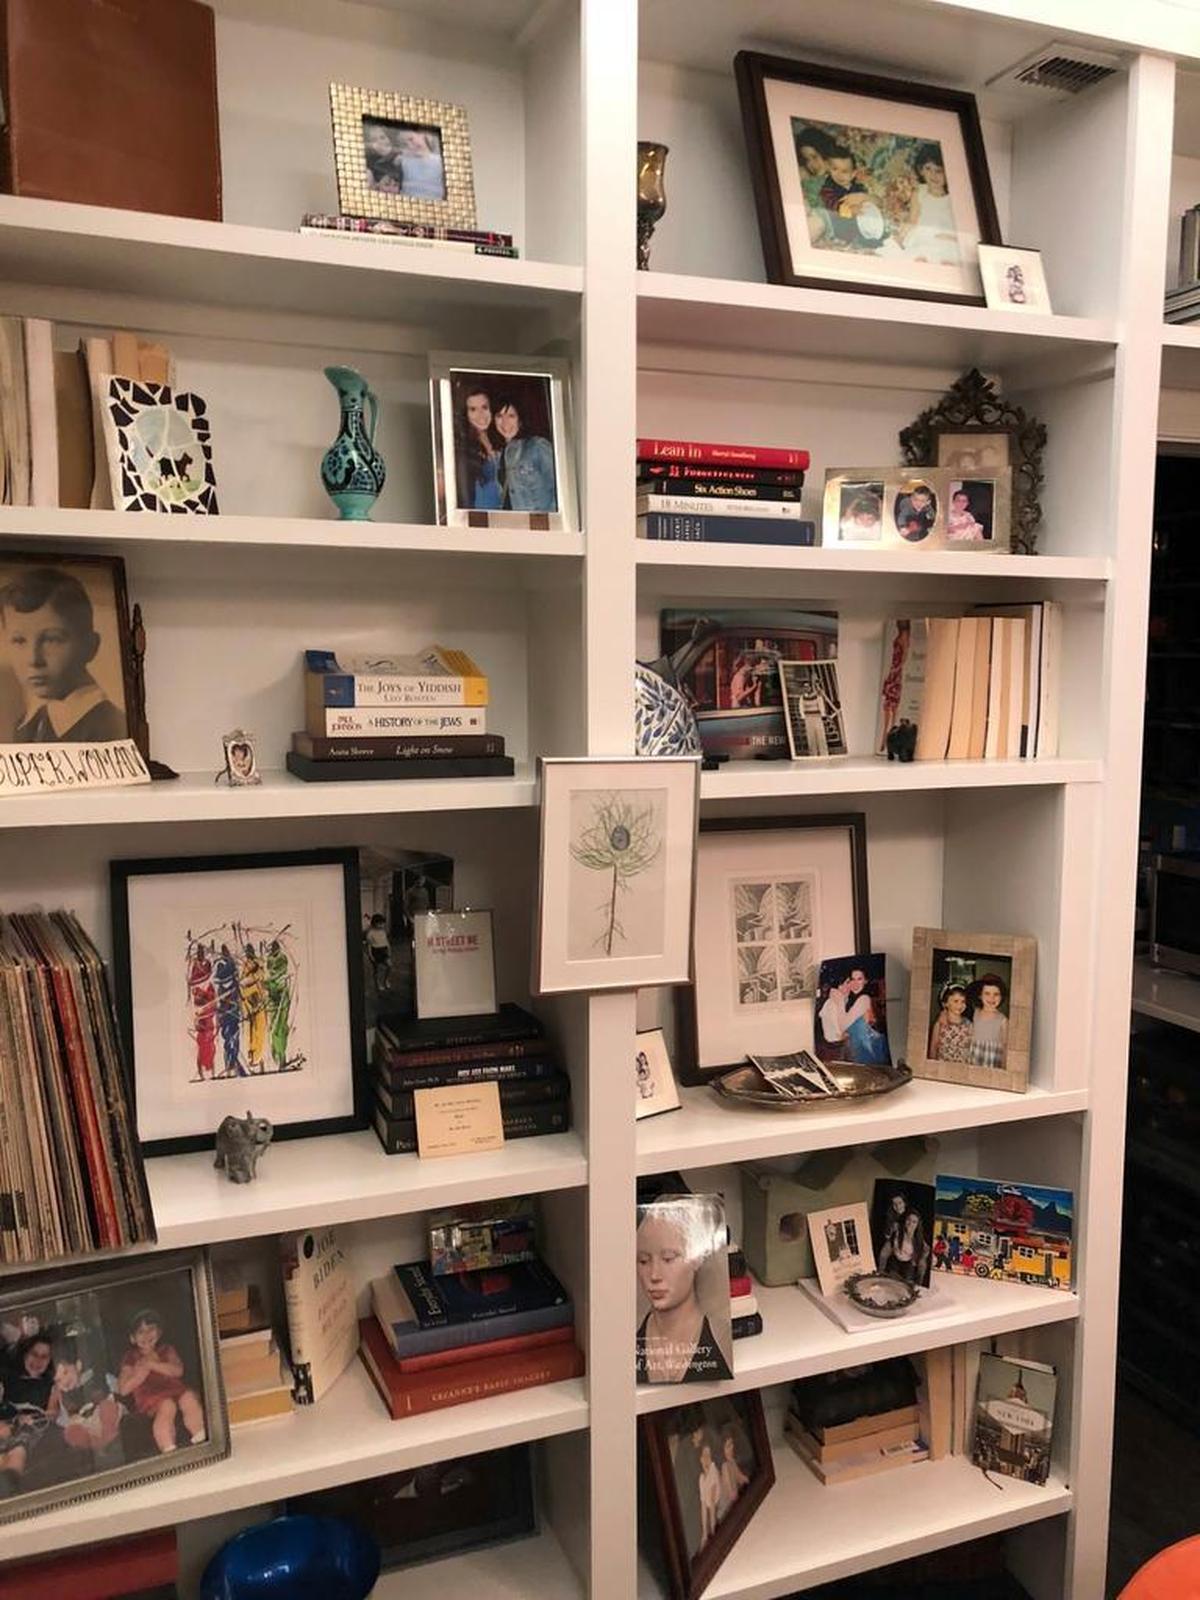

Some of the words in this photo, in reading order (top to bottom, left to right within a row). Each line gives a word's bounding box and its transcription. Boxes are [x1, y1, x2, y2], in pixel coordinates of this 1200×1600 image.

[654, 442, 685, 458] Lean
[694, 483, 708, 493] Six
[709, 485, 735, 495] Action
[674, 500, 713, 512] MINUTES
[358, 683, 374, 692] THE
[377, 681, 401, 693] JOYS
[418, 681, 462, 693] YIDDISH
[332, 723, 362, 731] JOHNSON
[375, 717, 413, 728] HISTORY
[440, 716, 462, 729] JEWS
[751, 736, 766, 746] THE
[396, 745, 418, 757] Light
[419, 746, 430, 754] on
[432, 744, 454, 754] Snow
[316, 1229, 337, 1259] JOE
[312, 1250, 345, 1289] BIDEN
[675, 1342, 713, 1358] Gallery
[664, 1359, 718, 1372] Washington
